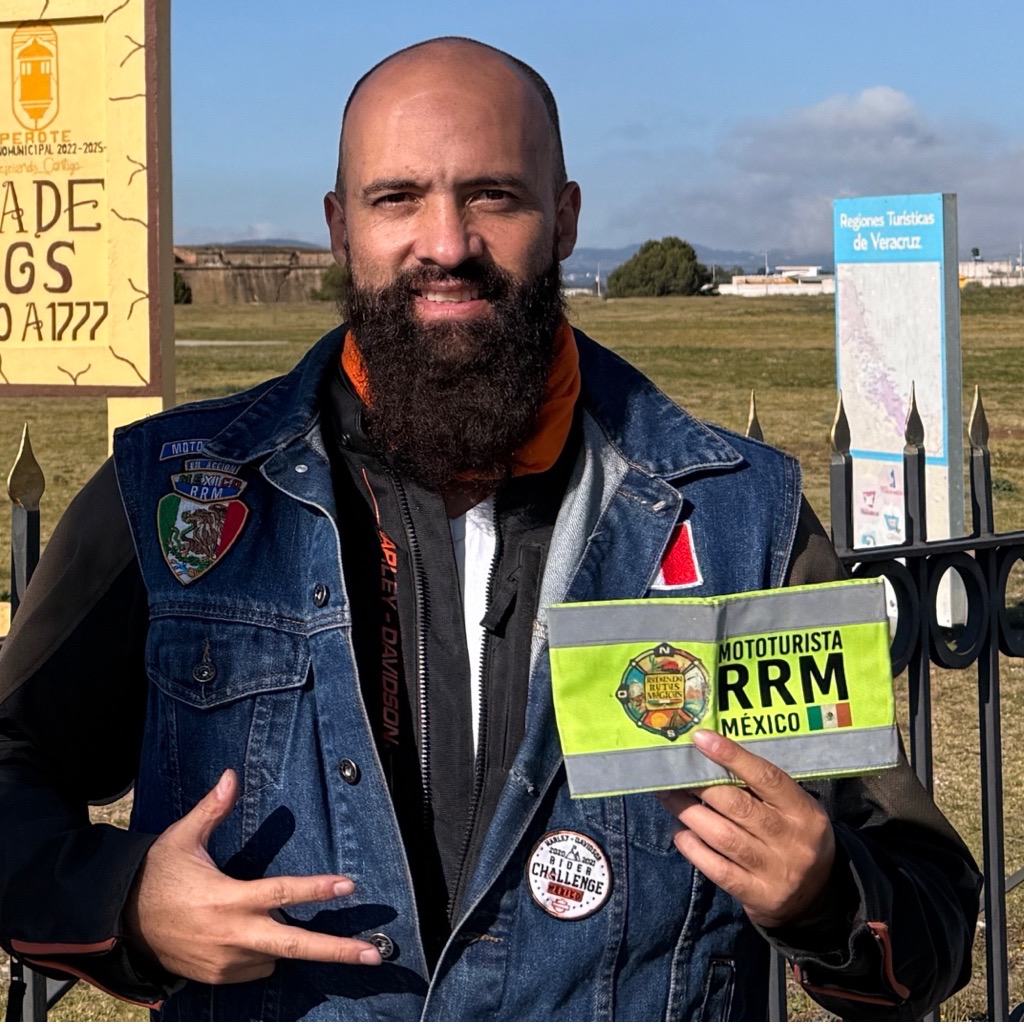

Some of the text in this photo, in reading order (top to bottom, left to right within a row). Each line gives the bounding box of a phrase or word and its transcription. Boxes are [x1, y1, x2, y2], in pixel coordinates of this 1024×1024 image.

[0, 130, 71, 145] PEROTE
[840, 213, 884, 231] Regiones
[853, 232, 922, 251] de Veracruz
[47, 301, 110, 343] 1777
[190, 485, 224, 500] RRM
[719, 630, 843, 663] MOTOTURISTA
[718, 652, 849, 712] RRM
[721, 712, 800, 737] MÉXICO
[549, 855, 592, 876] RIDER
[532, 862, 604, 895] CHALLENGE
